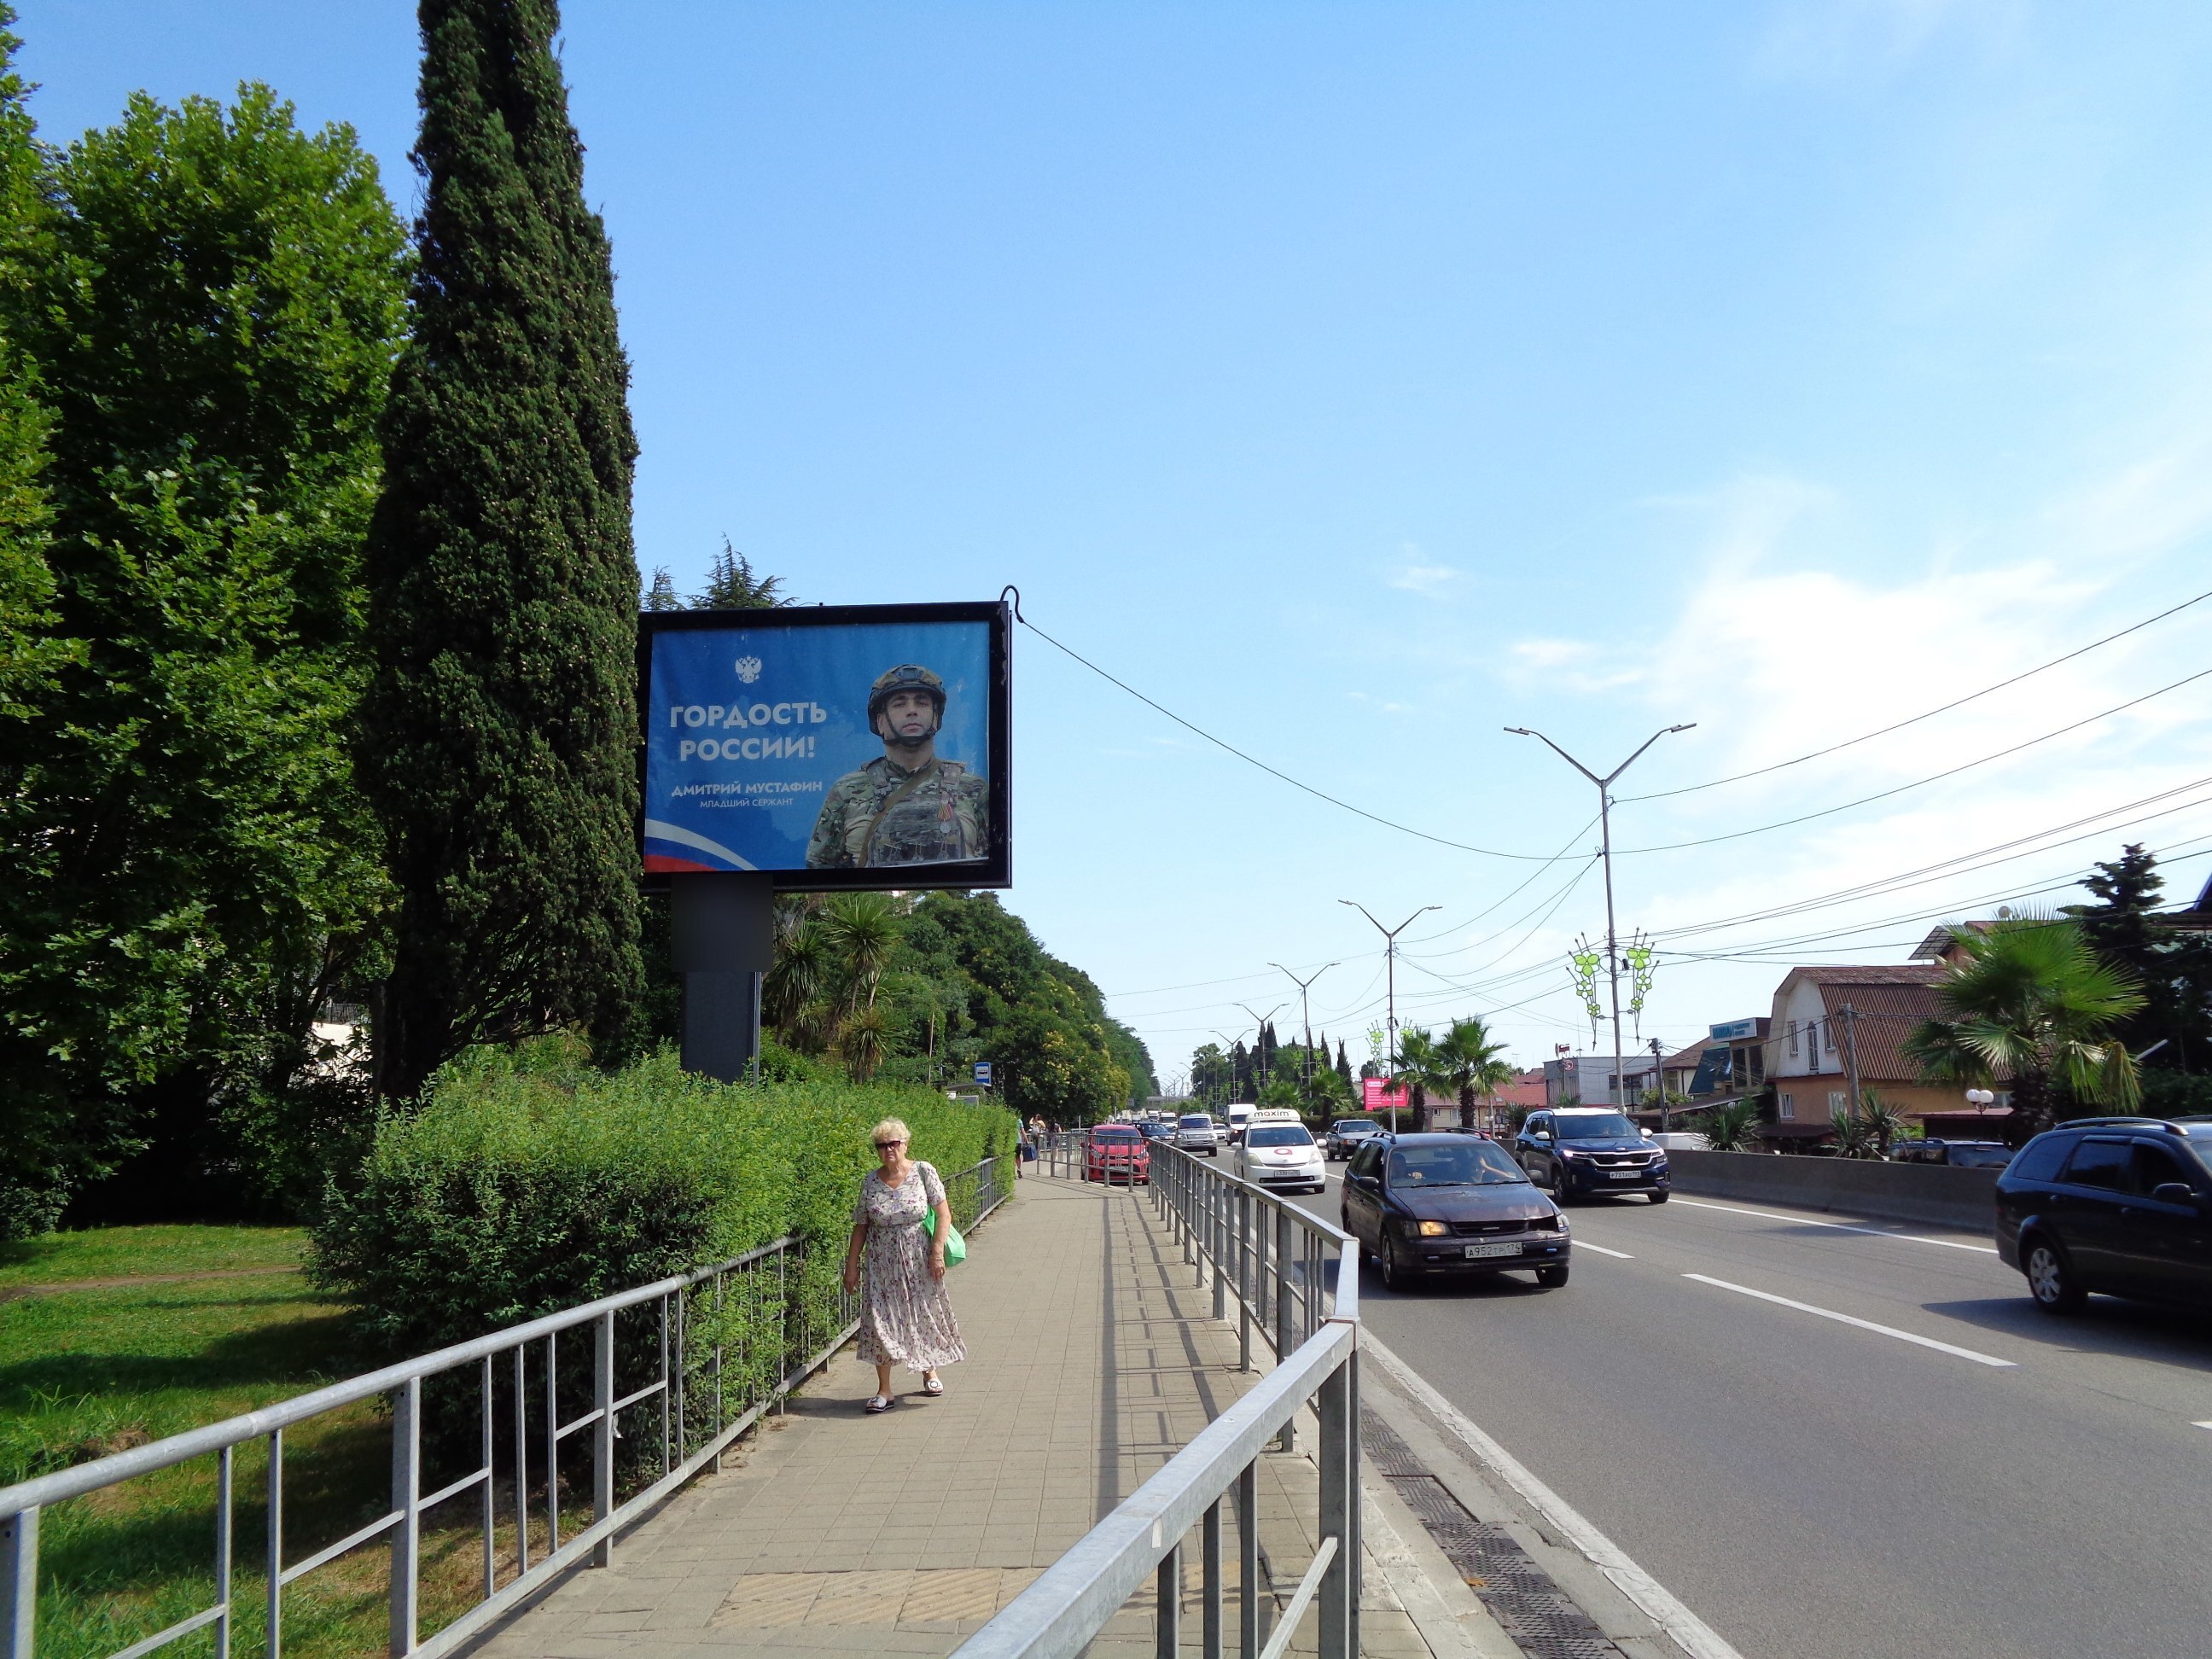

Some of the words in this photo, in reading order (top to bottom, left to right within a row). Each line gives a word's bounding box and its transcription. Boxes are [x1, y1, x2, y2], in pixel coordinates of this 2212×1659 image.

[670, 702, 827, 729] ГОРДОСТЬ
[680, 736, 814, 761] РОССИИ!
[672, 781, 741, 796] ДМИТРИЙ
[746, 782, 822, 794] МУСТАФИН
[700, 797, 749, 808] МЛАДШИЙ
[752, 798, 794, 806] СЕРЖАНТ
[1254, 1109, 1289, 1118] maxim
